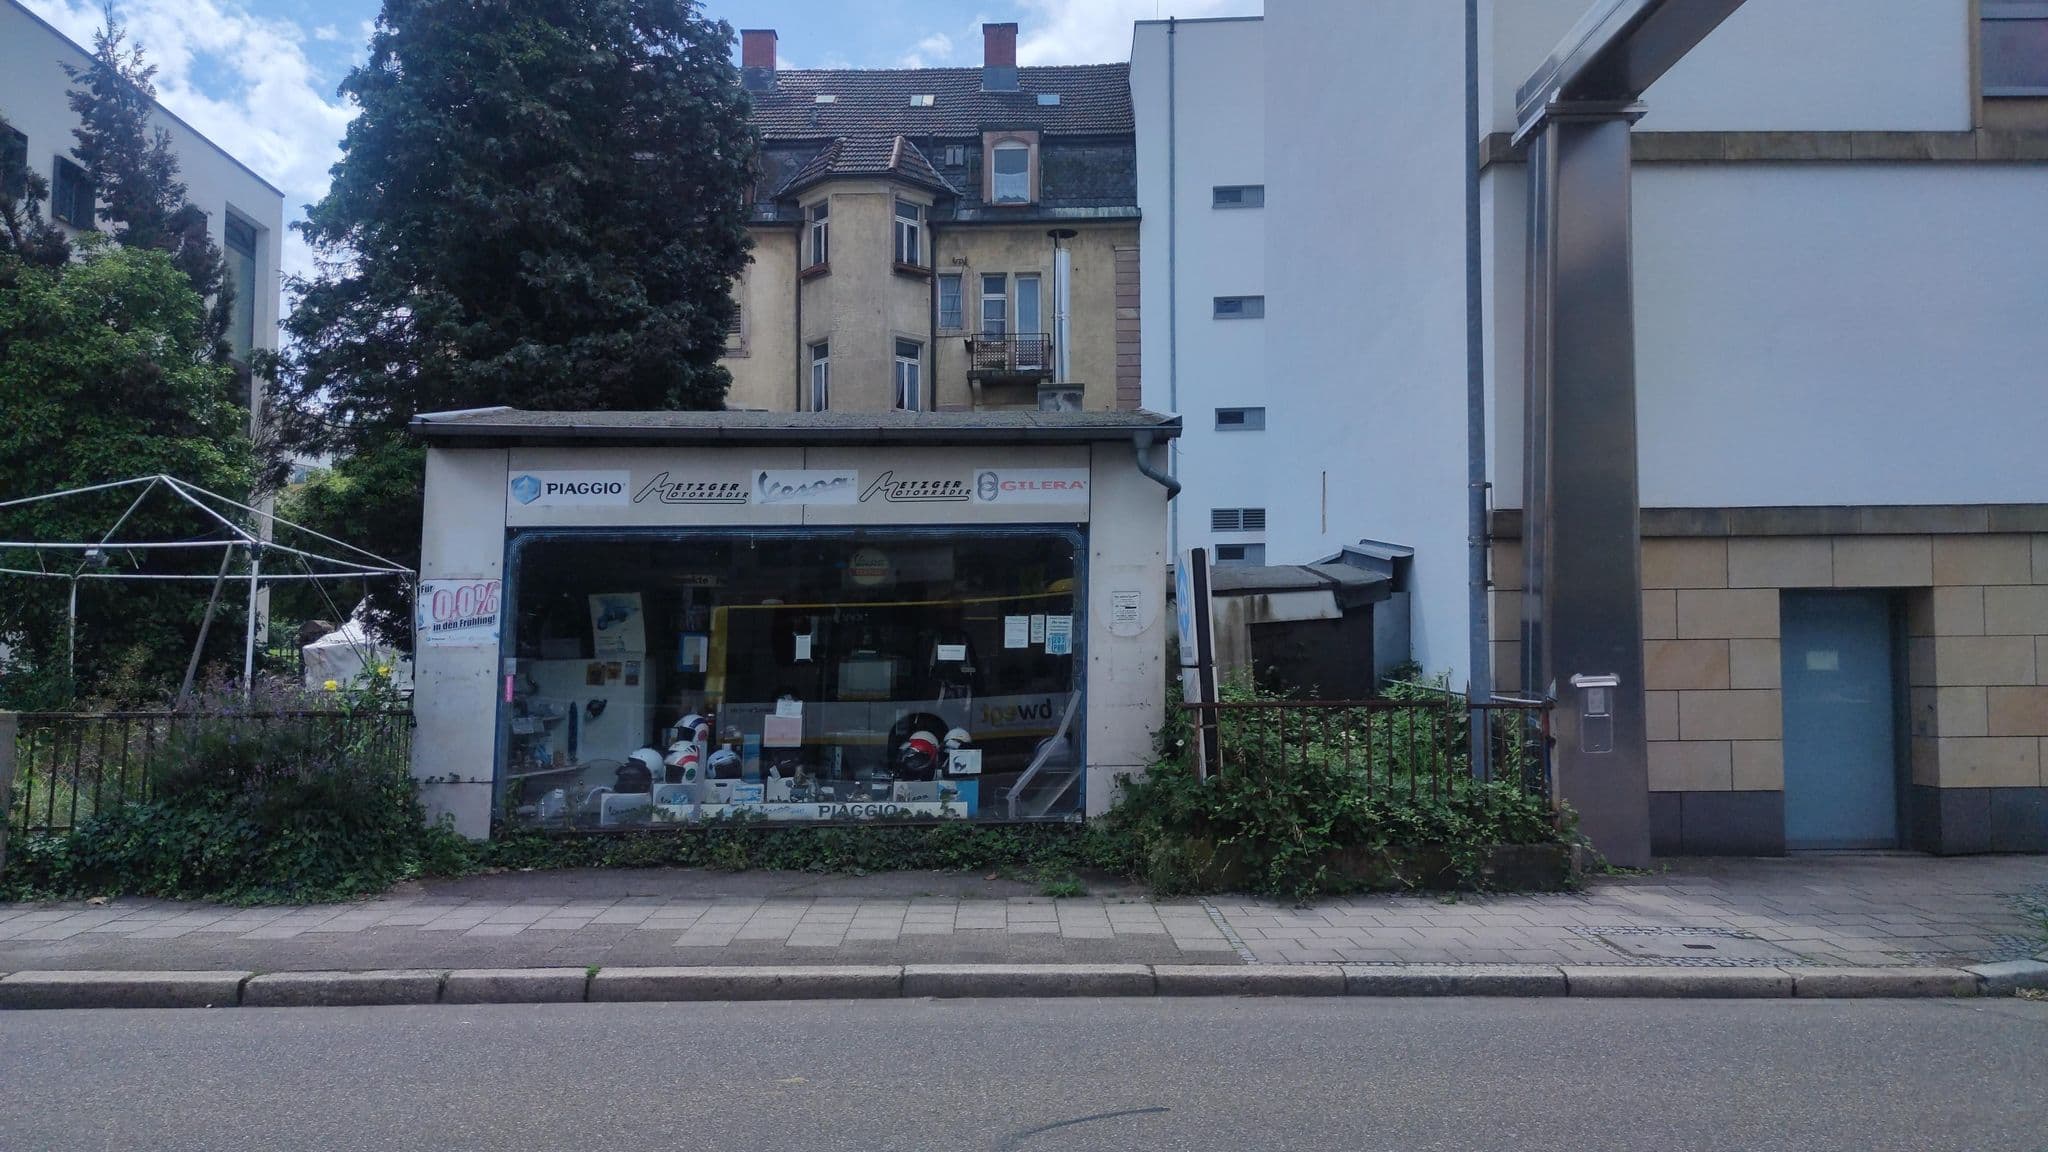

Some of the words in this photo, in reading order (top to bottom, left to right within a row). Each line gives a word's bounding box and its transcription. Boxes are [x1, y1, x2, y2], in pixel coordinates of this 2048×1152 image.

[546, 481, 622, 496] PIAGGIO
[1000, 480, 1084, 491] GILERA
[420, 584, 434, 594] Für
[433, 622, 442, 632] in
[442, 620, 459, 631] den
[818, 804, 898, 818] PIAGGIO
